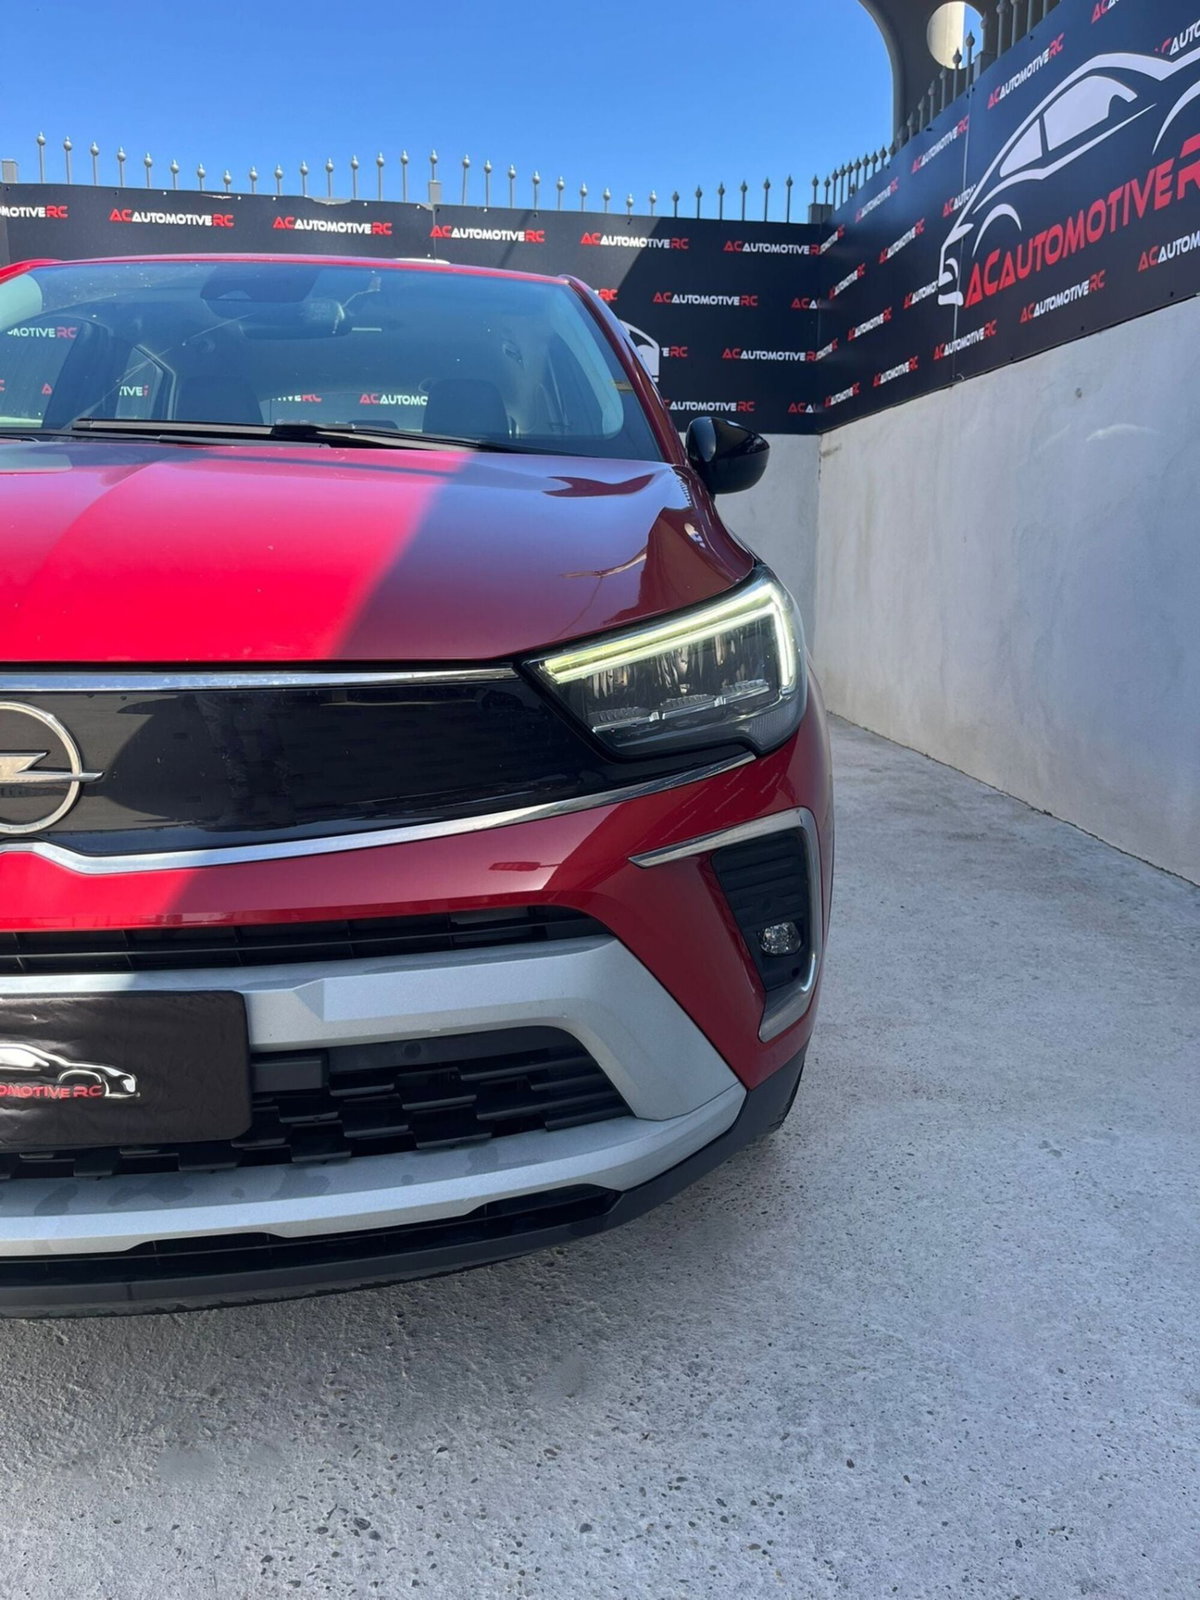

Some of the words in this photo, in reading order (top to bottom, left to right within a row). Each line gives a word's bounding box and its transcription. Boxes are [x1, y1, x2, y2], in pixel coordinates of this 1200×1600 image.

[987, 33, 1064, 110] ACAUTOMOTIVERC
[109, 208, 234, 228] ACAUTOMOTIVERC
[273, 216, 392, 235] ACAUTOMOTIVERC
[430, 225, 545, 243] ACAUTOMOTIVERC
[580, 232, 689, 250] ACAUTOMOTIVERC
[653, 292, 758, 307] ACAUTOMOTIVERC
[1019, 269, 1106, 324] ACAUTOMOTIVERC
[934, 320, 997, 360] ACAUTOMOTIVERC
[664, 400, 755, 413] AUTOMOTIVERC
